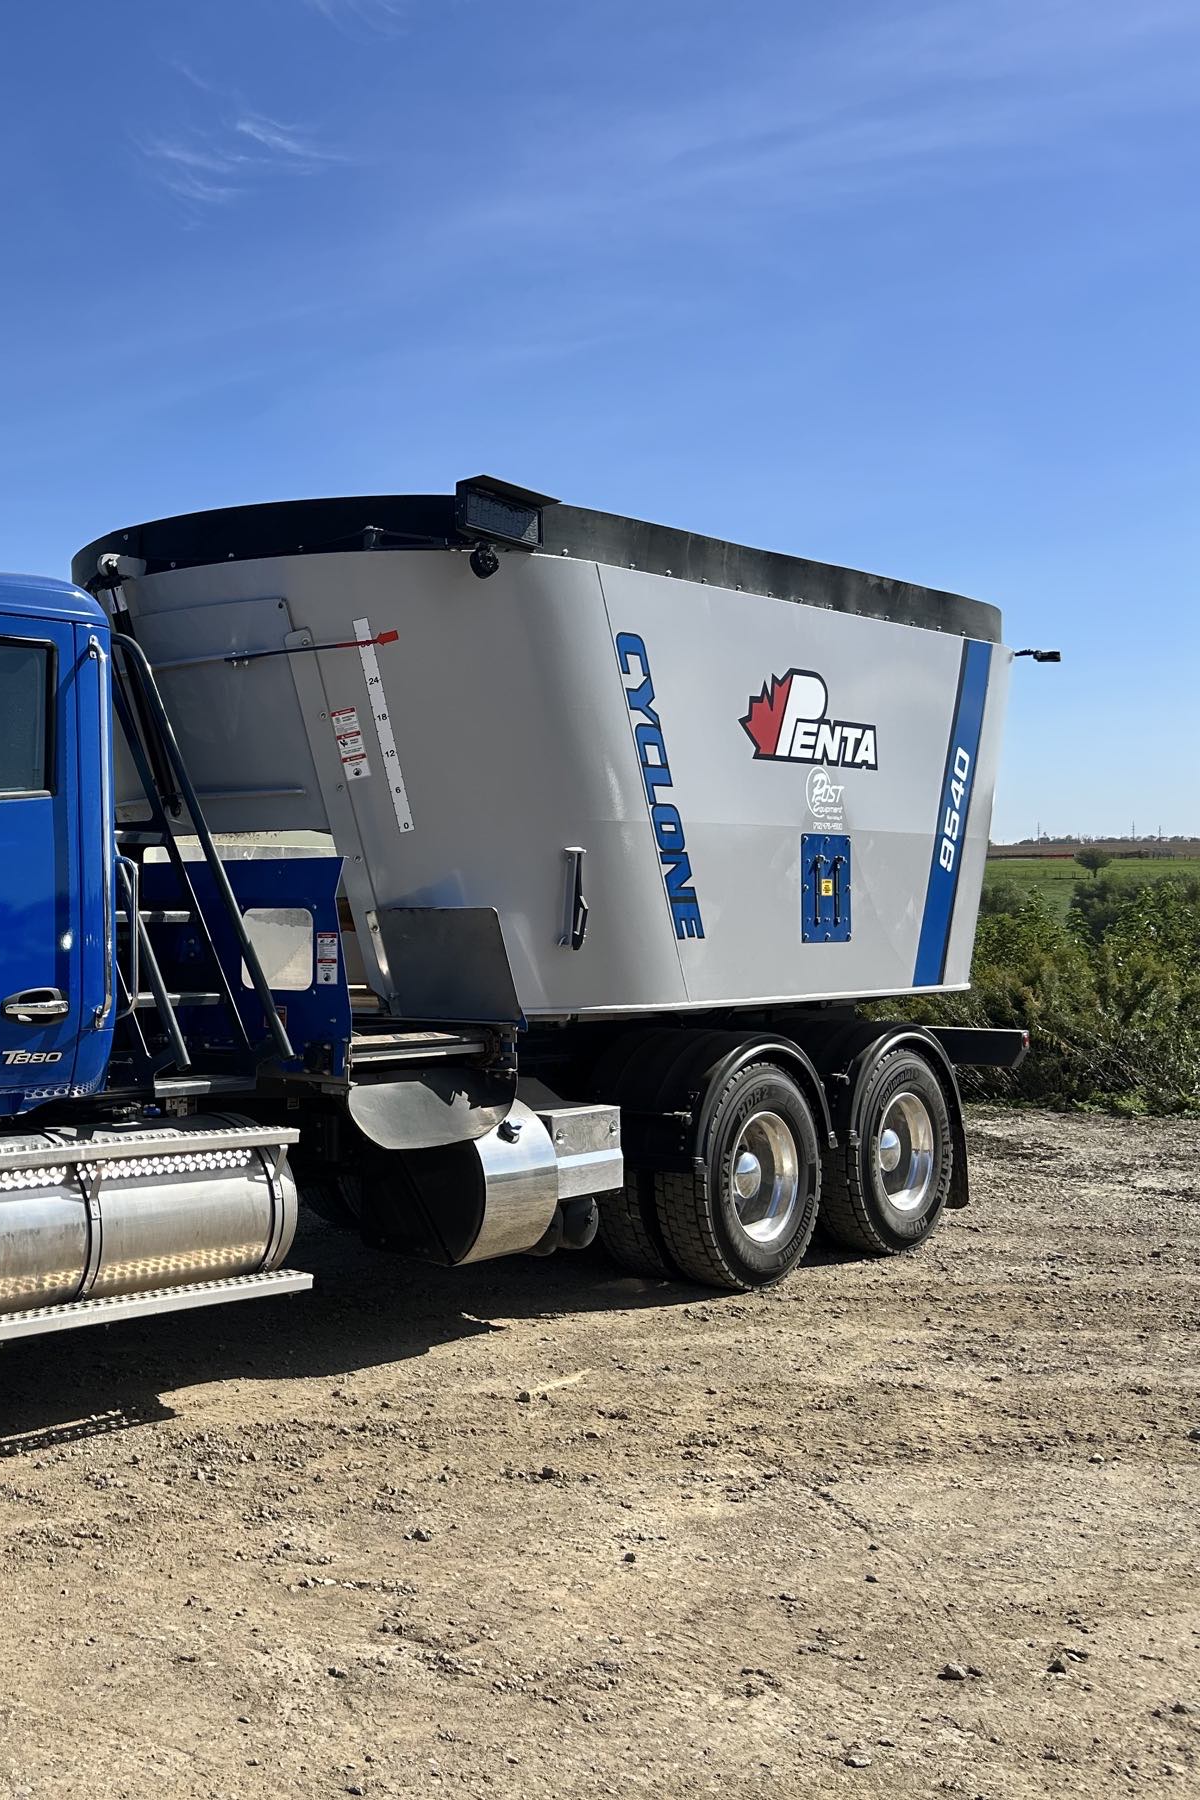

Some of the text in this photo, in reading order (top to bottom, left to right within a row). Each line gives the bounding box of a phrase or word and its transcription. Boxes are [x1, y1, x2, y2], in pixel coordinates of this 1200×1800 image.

[368, 676, 380, 685] 24
[376, 713, 388, 721] 18
[774, 671, 877, 768] PENTA
[384, 749, 396, 758] 12
[395, 786, 402, 794] 6
[616, 632, 705, 939] CYCLONE
[939, 746, 970, 873] 9540
[403, 822, 409, 830] 0
[2, 1050, 63, 1064] T880
